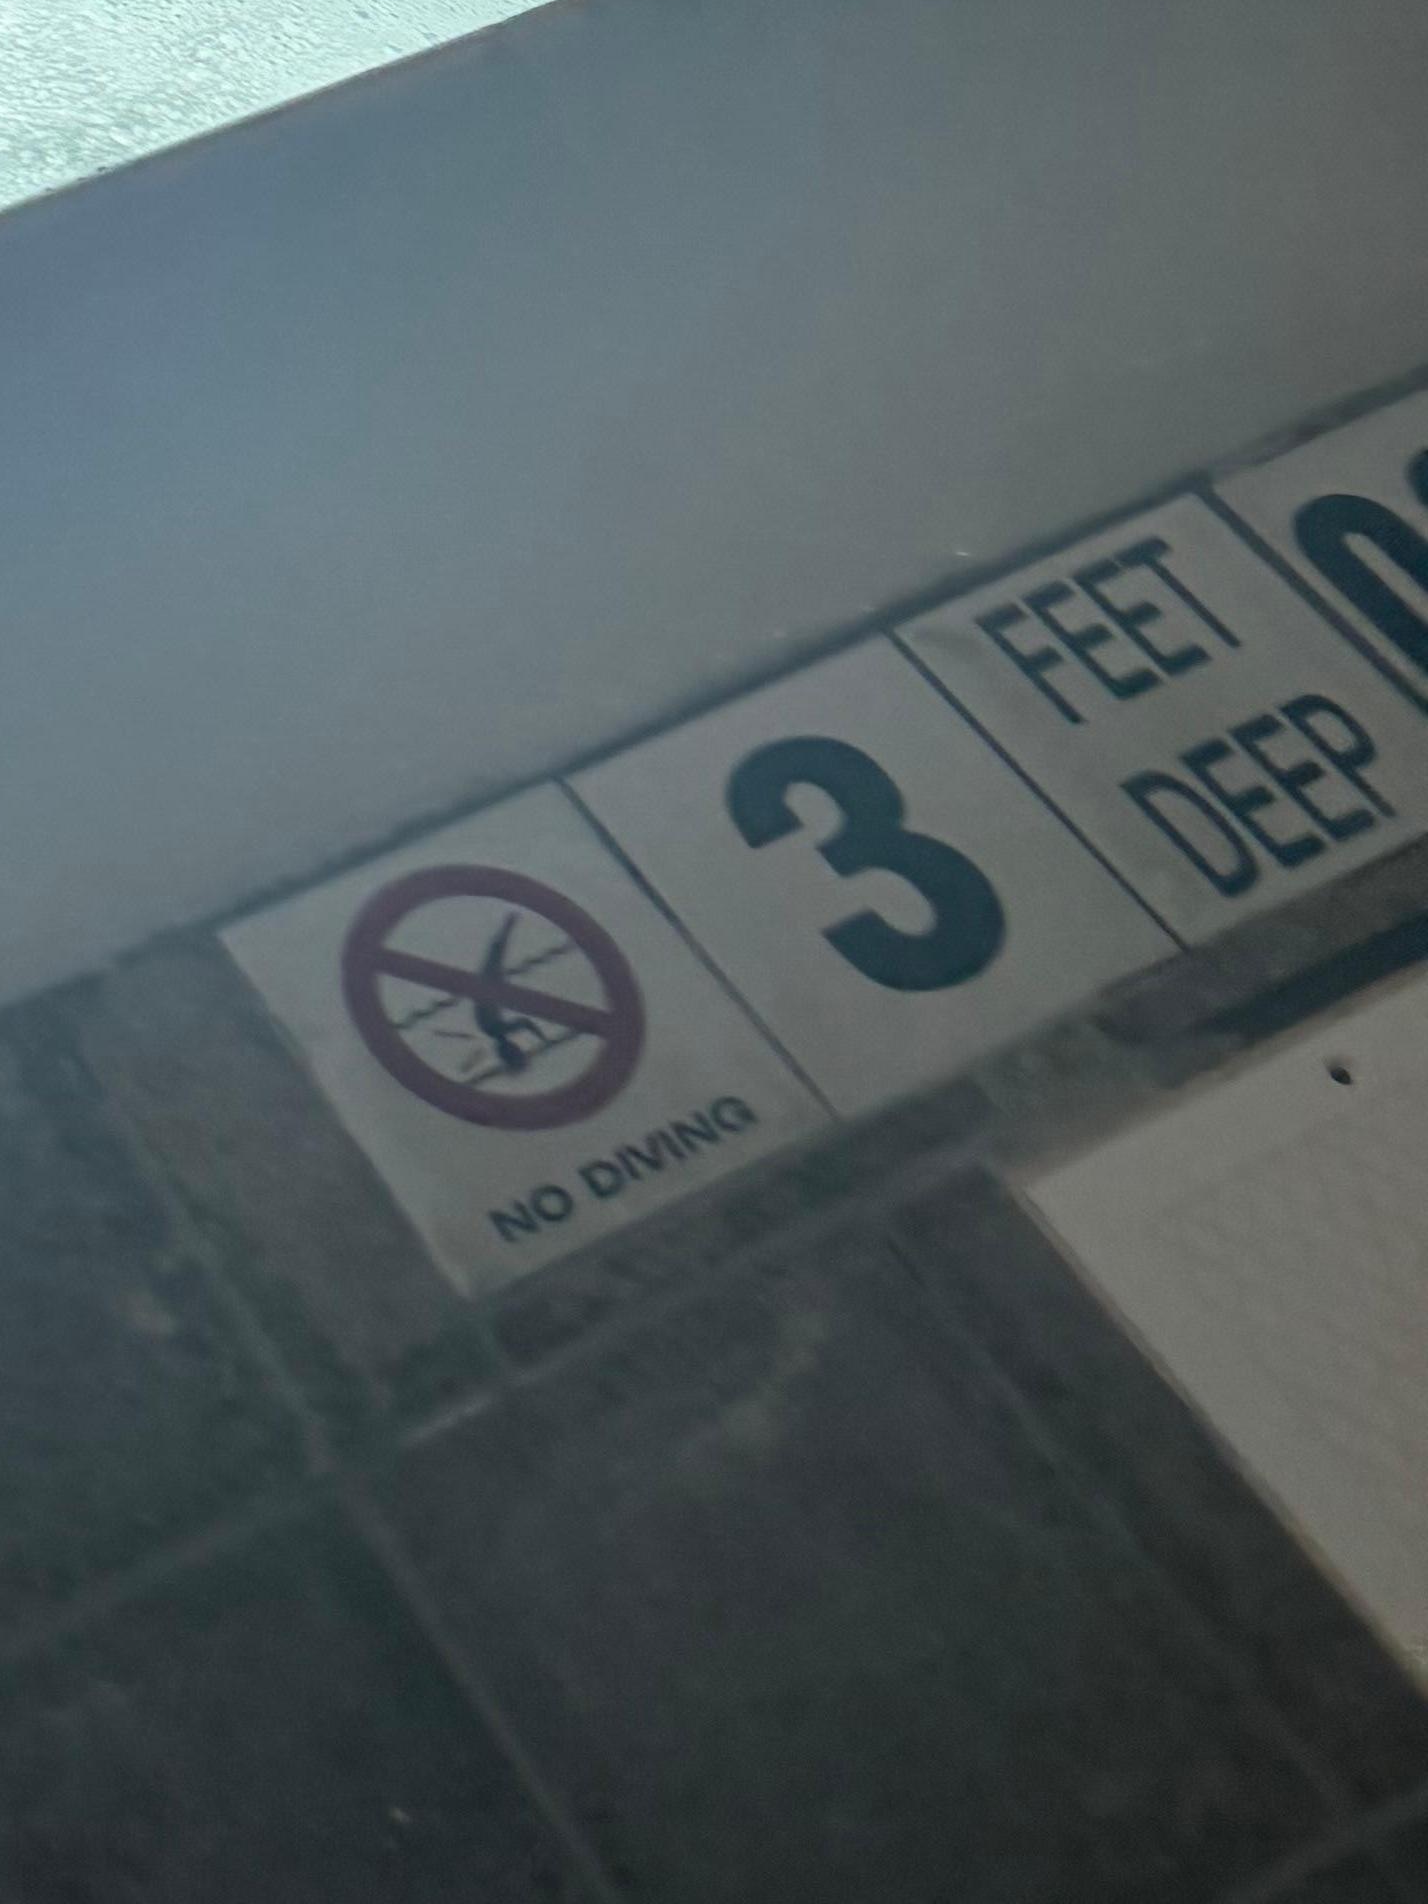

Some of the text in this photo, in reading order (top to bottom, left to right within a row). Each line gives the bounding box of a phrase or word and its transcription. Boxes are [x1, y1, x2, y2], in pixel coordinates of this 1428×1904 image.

[973, 537, 1242, 725] FEET
[726, 735, 1007, 993] 3
[1119, 693, 1398, 899] DEEP
[487, 1095, 761, 1243] NO DIVING
